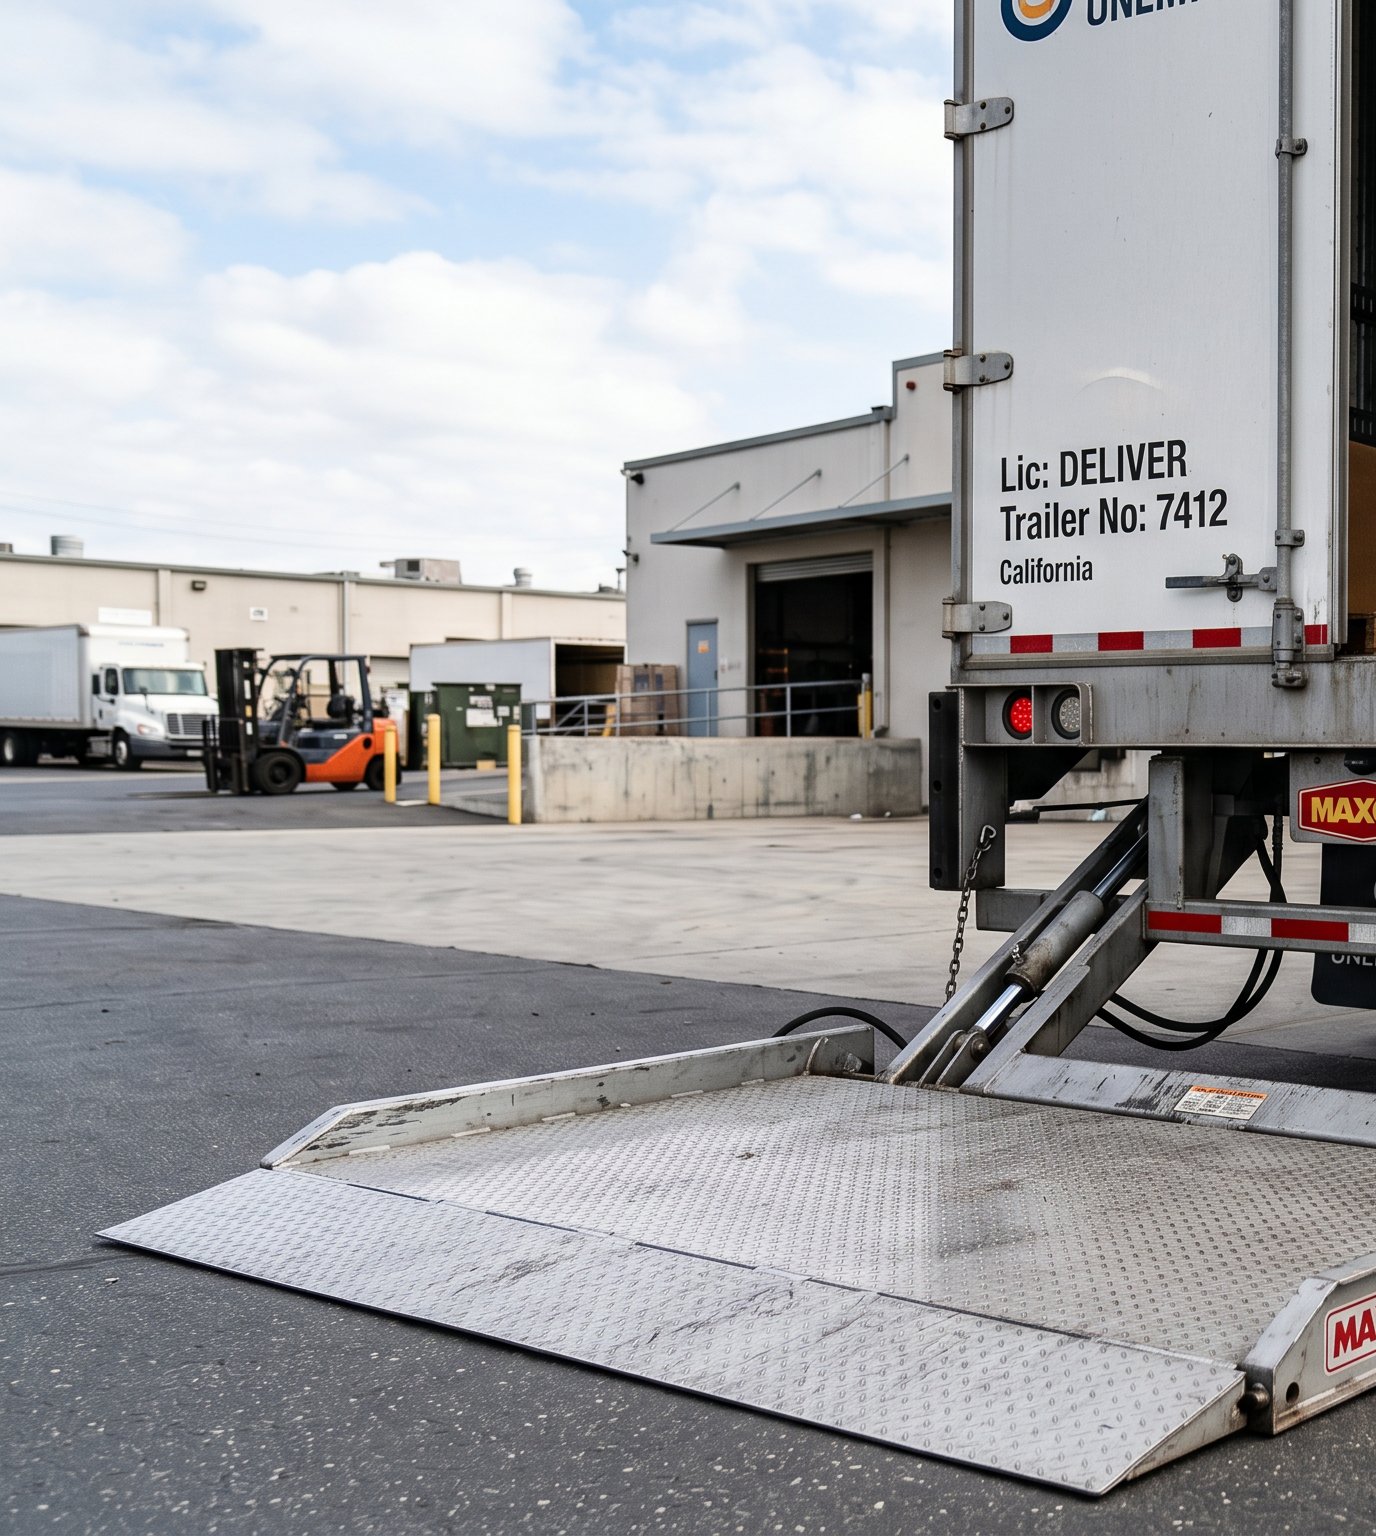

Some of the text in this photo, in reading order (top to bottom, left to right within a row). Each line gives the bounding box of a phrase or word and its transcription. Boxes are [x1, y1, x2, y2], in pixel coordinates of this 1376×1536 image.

[1000, 439, 1187, 493] Lic: DELIVER
[1000, 488, 1228, 541] Trailer No: 7412
[1000, 555, 1093, 585] California
